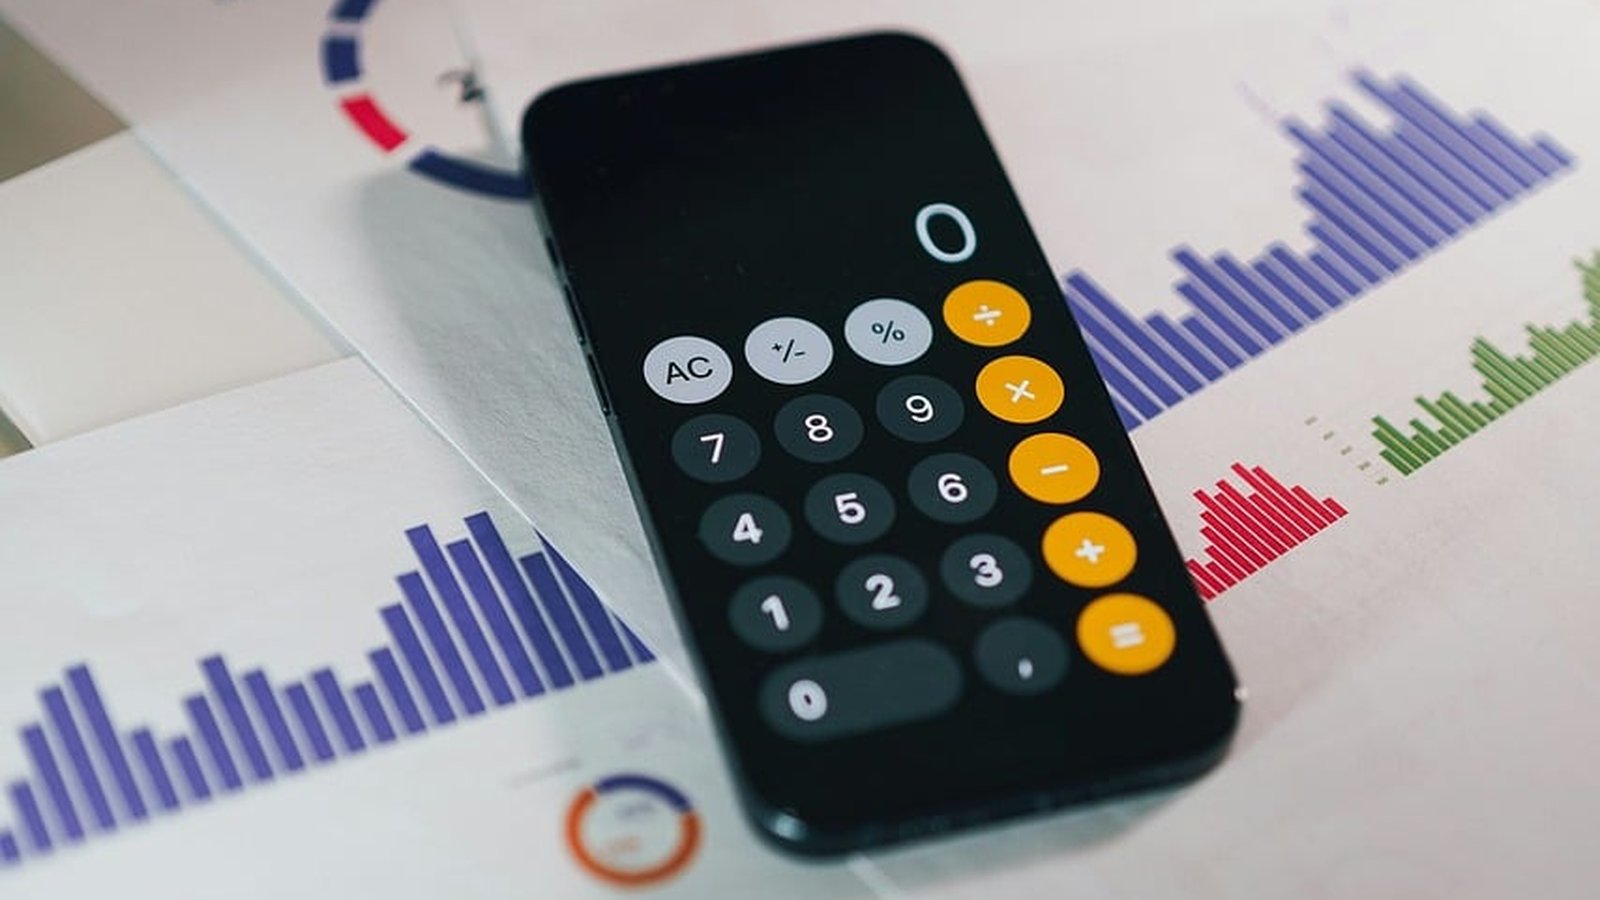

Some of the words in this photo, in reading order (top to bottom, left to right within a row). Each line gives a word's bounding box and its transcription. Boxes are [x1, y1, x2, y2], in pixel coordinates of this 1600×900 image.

[915, 203, 977, 263] 0
[666, 356, 714, 385] AC
[871, 319, 906, 345] %
[700, 433, 724, 464] 7
[804, 414, 834, 443] 8
[905, 394, 934, 423] 9
[732, 512, 763, 544] 4
[835, 492, 866, 524] 5
[937, 473, 968, 503] 6
[761, 595, 789, 630] 1
[865, 574, 901, 610] 2
[969, 553, 1003, 587] 3
[1075, 539, 1105, 563] +
[788, 679, 828, 721] 0
